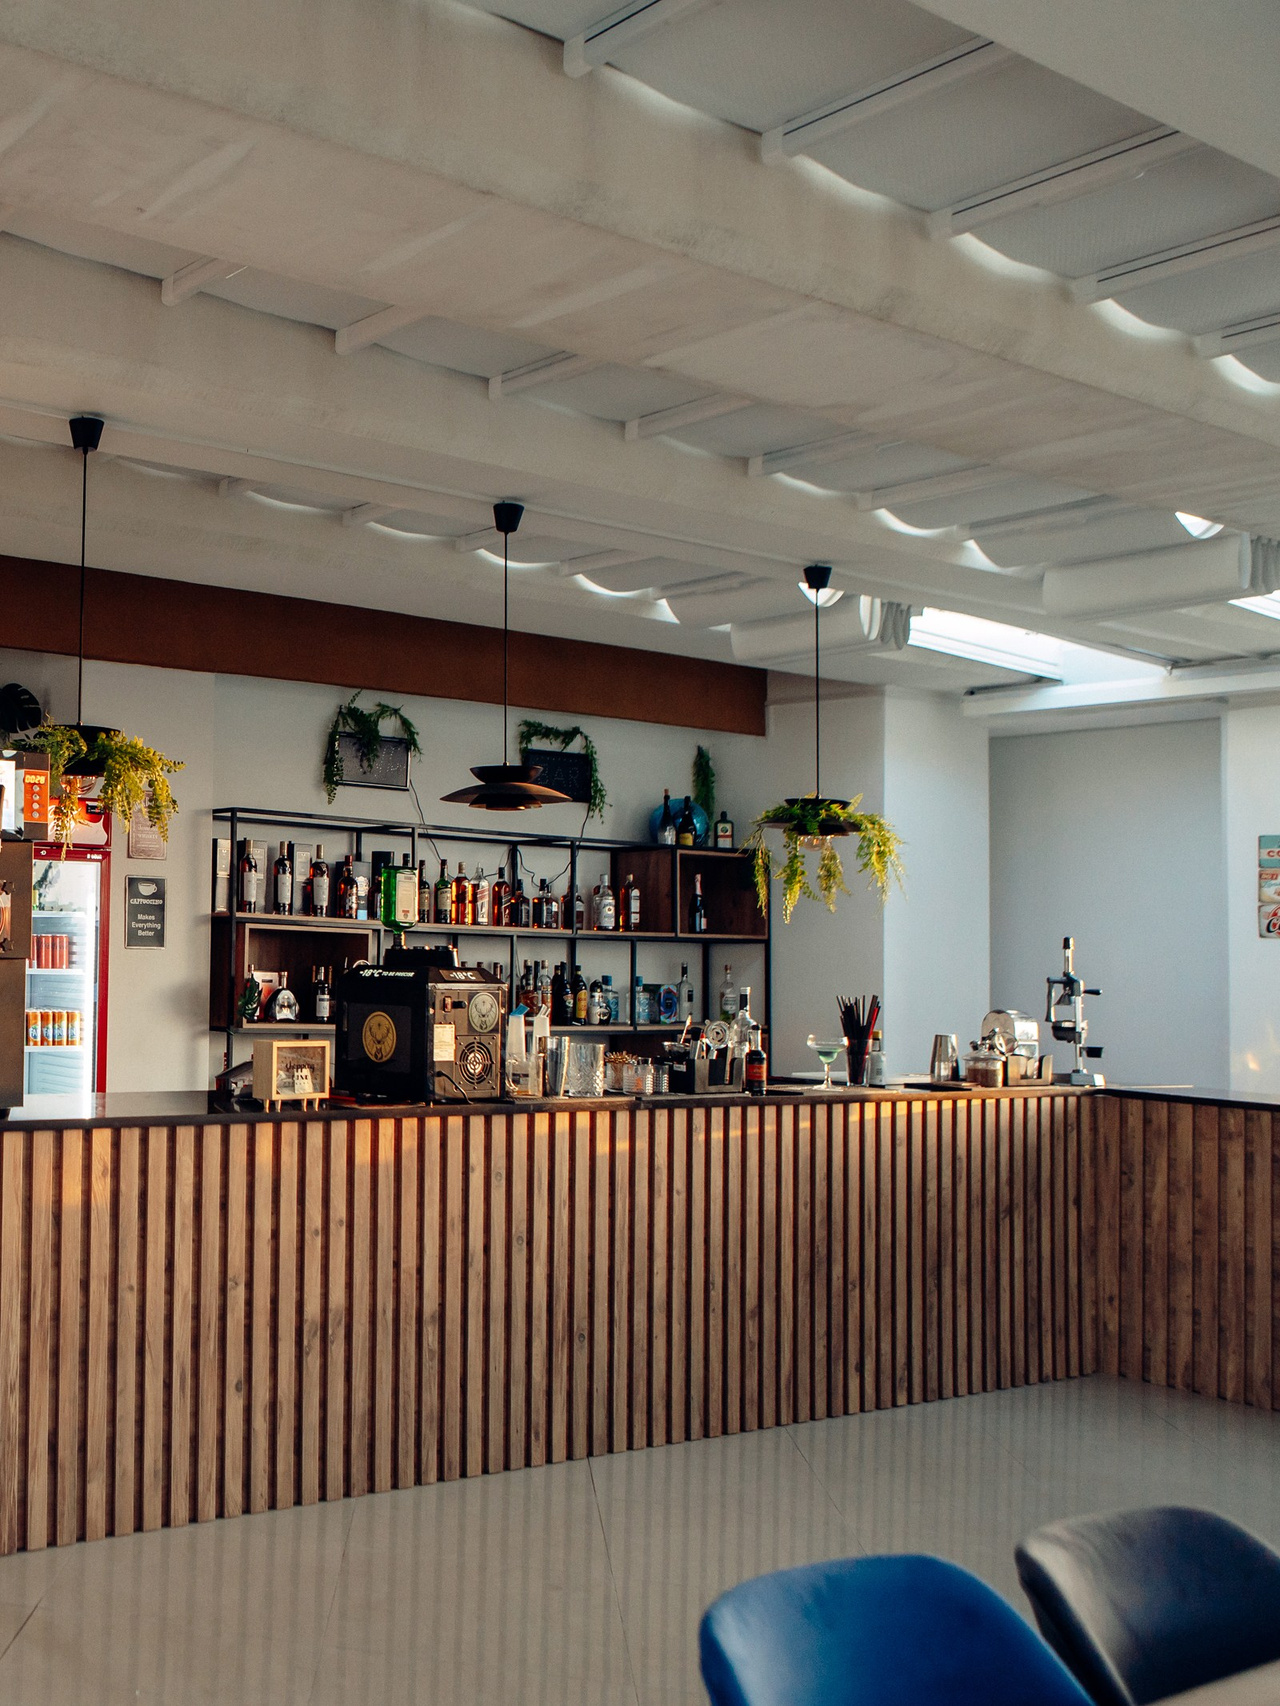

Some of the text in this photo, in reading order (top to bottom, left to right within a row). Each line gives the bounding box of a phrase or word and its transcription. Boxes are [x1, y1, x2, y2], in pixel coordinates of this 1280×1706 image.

[137, 913, 155, 921] Makes
[131, 921, 161, 930] Everything
[137, 929, 155, 937] Better
